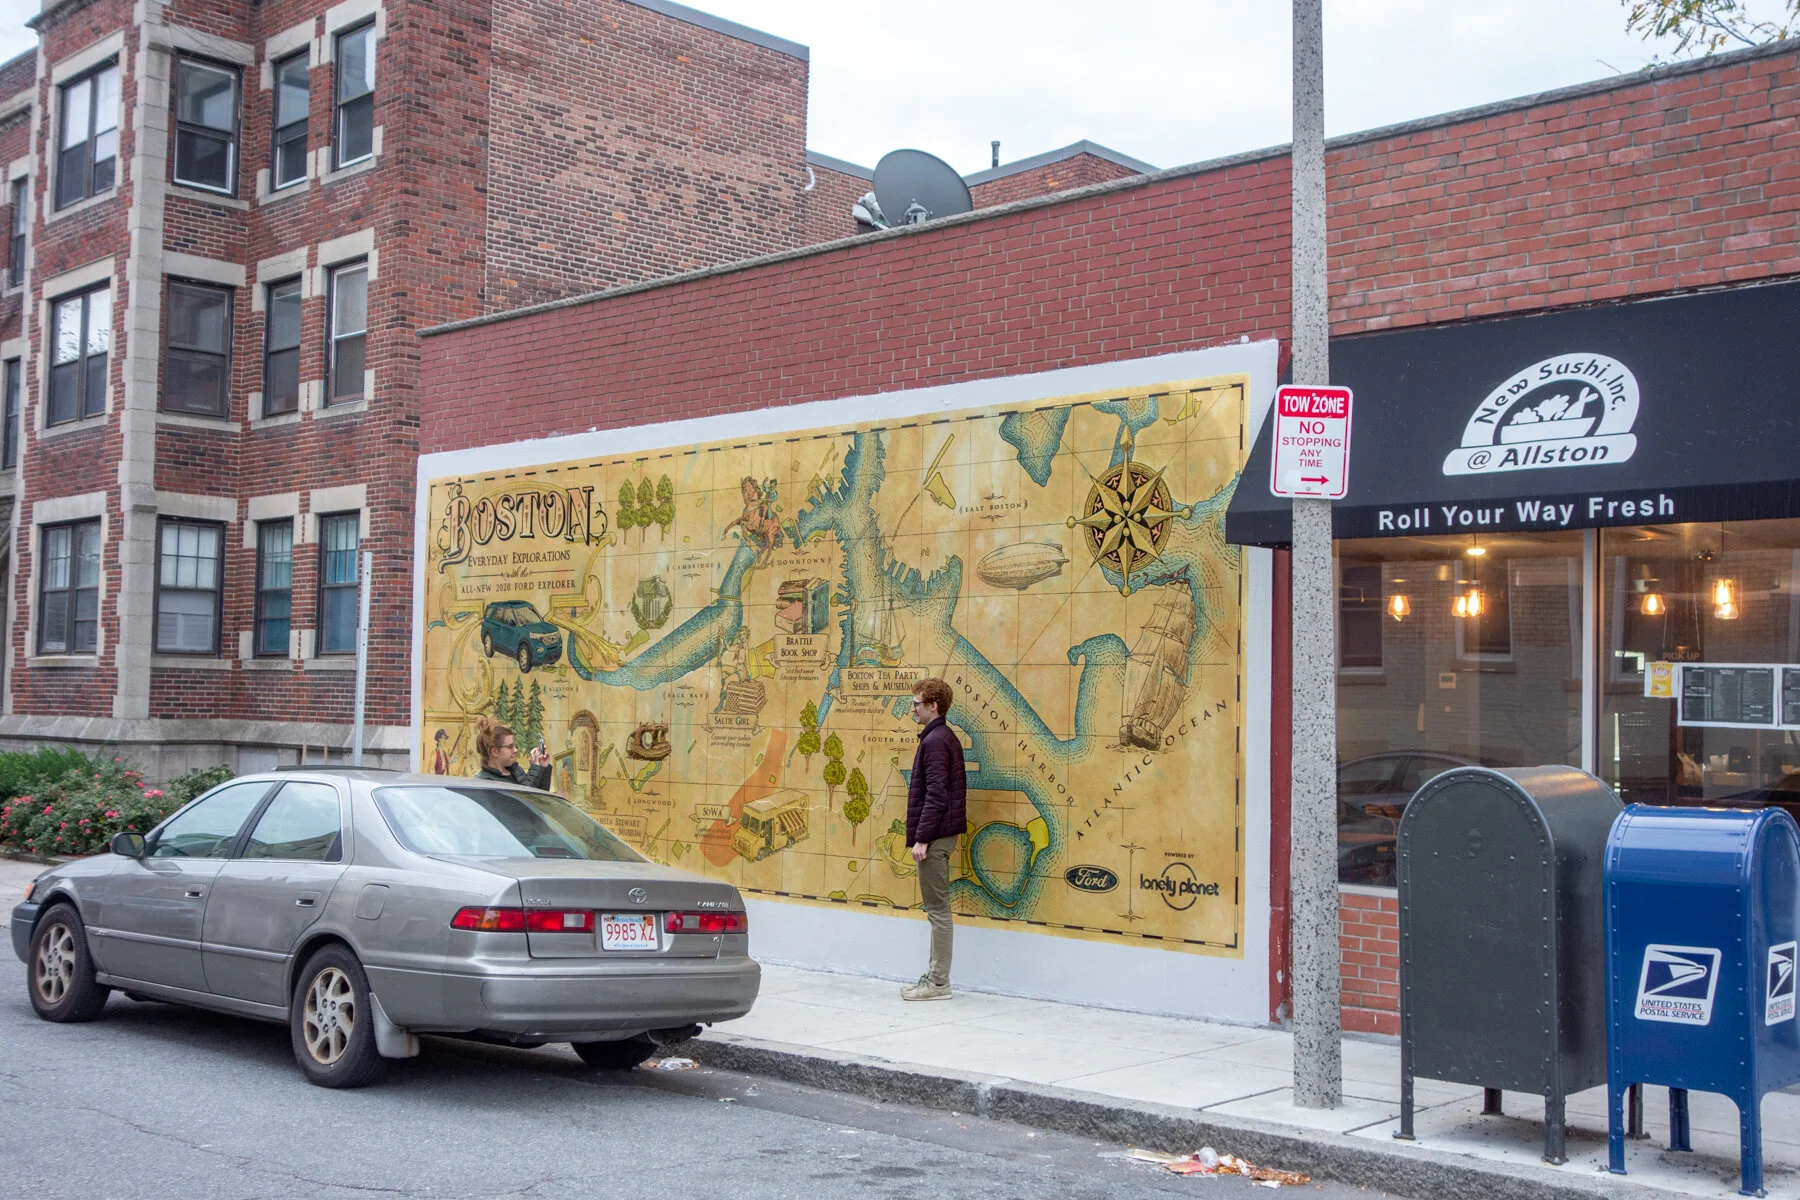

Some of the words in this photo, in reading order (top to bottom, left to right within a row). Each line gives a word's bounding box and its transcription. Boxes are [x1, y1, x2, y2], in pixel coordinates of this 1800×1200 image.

[1283, 396, 1310, 412] TOW
[1311, 396, 1345, 414] ZONE
[1474, 378, 1528, 425] New
[1299, 421, 1325, 434] NO
[1282, 437, 1341, 448] STOPPING
[1300, 449, 1322, 457] ANY
[1467, 450, 1492, 470] @
[1498, 445, 1609, 468] Allston
[1299, 459, 1323, 467] TIME
[990, 502, 1021, 510] BOSTON
[1378, 508, 1430, 531] Roll
[1441, 506, 1504, 526] Your
[1516, 501, 1574, 526] Way
[1588, 494, 1675, 519] Fresh
[438, 484, 596, 574] BOSTON
[468, 554, 508, 568] EVERYDAY
[512, 550, 571, 564] EXPLORATIONS
[461, 584, 491, 594] ALL-NEW
[496, 583, 511, 592] 2020
[514, 582, 534, 590] FORD
[538, 580, 576, 590] EXPLORER
[786, 636, 813, 645] BRATTLE
[781, 648, 798, 656] BOOK
[802, 648, 818, 656] SHOP
[1687, 652, 1700, 660] UP
[847, 670, 875, 680] BOSTON
[878, 670, 891, 680] TEA
[895, 670, 919, 680] PARTY
[873, 681, 879, 690] &
[955, 675, 1010, 731] BOSTON
[1018, 740, 1075, 807] HARBOR
[1076, 754, 1153, 841] ATLANTIC
[1165, 700, 1228, 746] OCEAN
[1075, 868, 1108, 888] Ford
[1140, 873, 1176, 897] lonely
[1179, 878, 1219, 896] planet
[606, 923, 637, 941] 9985
[639, 923, 655, 941] XZ
[1641, 999, 1672, 1009] UNITED
[1673, 1002, 1702, 1011] STATES
[1640, 1007, 1670, 1017] POSTAL
[1671, 1010, 1704, 1020] SERVICE
